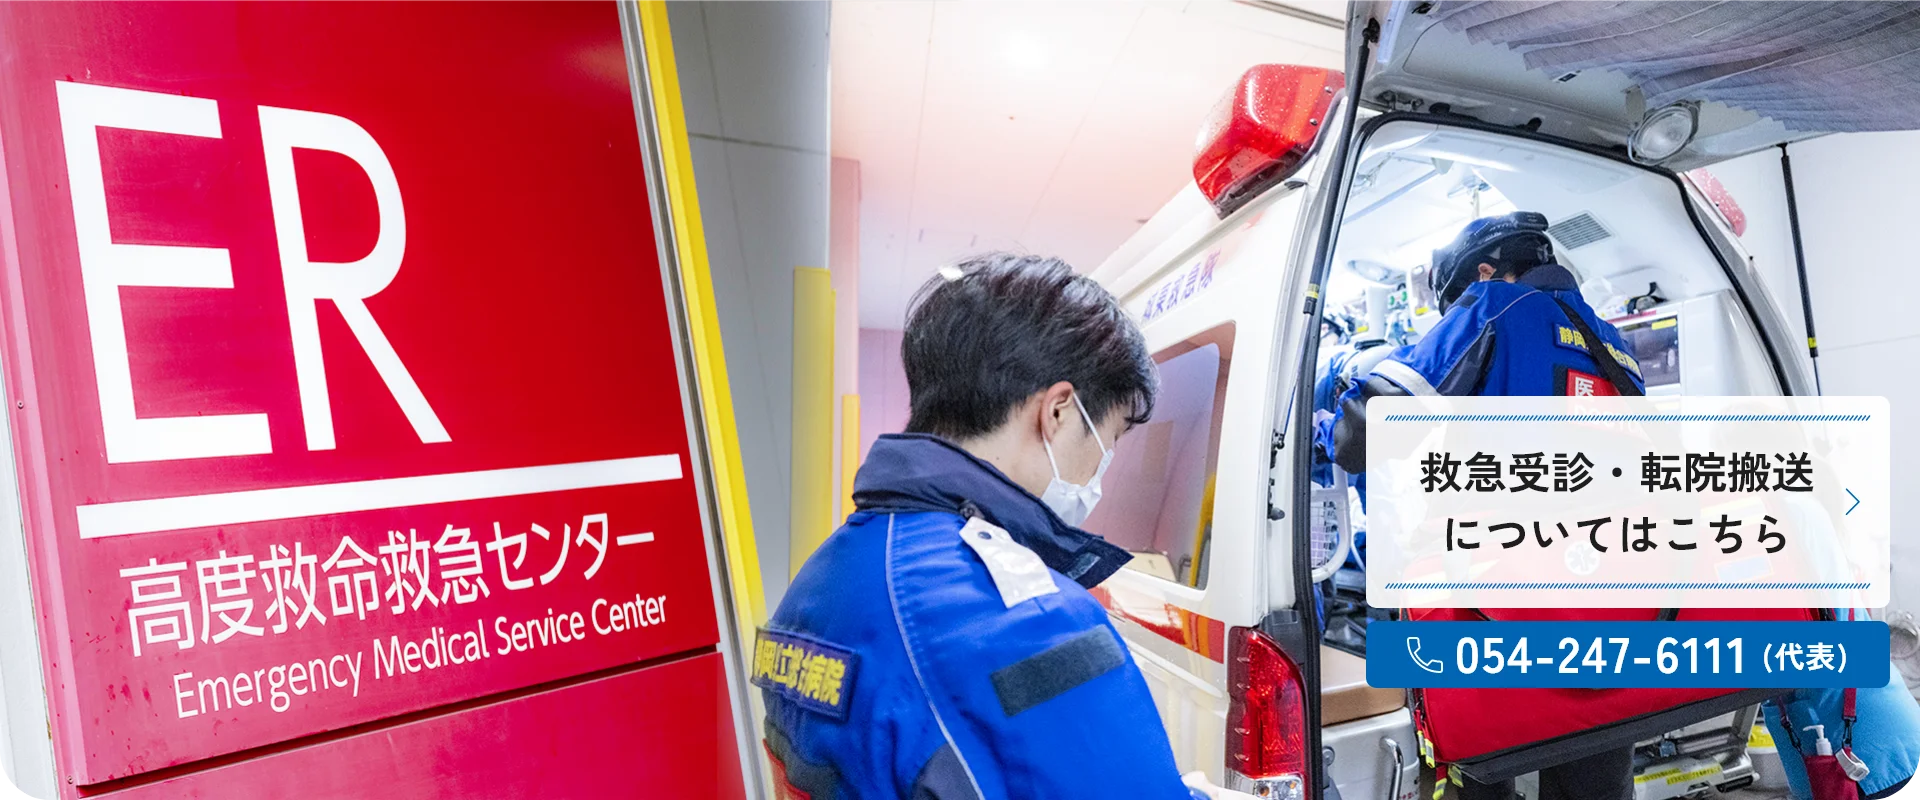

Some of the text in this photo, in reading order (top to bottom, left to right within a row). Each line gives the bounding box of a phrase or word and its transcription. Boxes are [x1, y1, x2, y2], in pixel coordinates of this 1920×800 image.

[55, 80, 452, 464] ER
[118, 512, 655, 658] 高度救命救急センター
[173, 593, 667, 719] Emergency Medical Service Center
